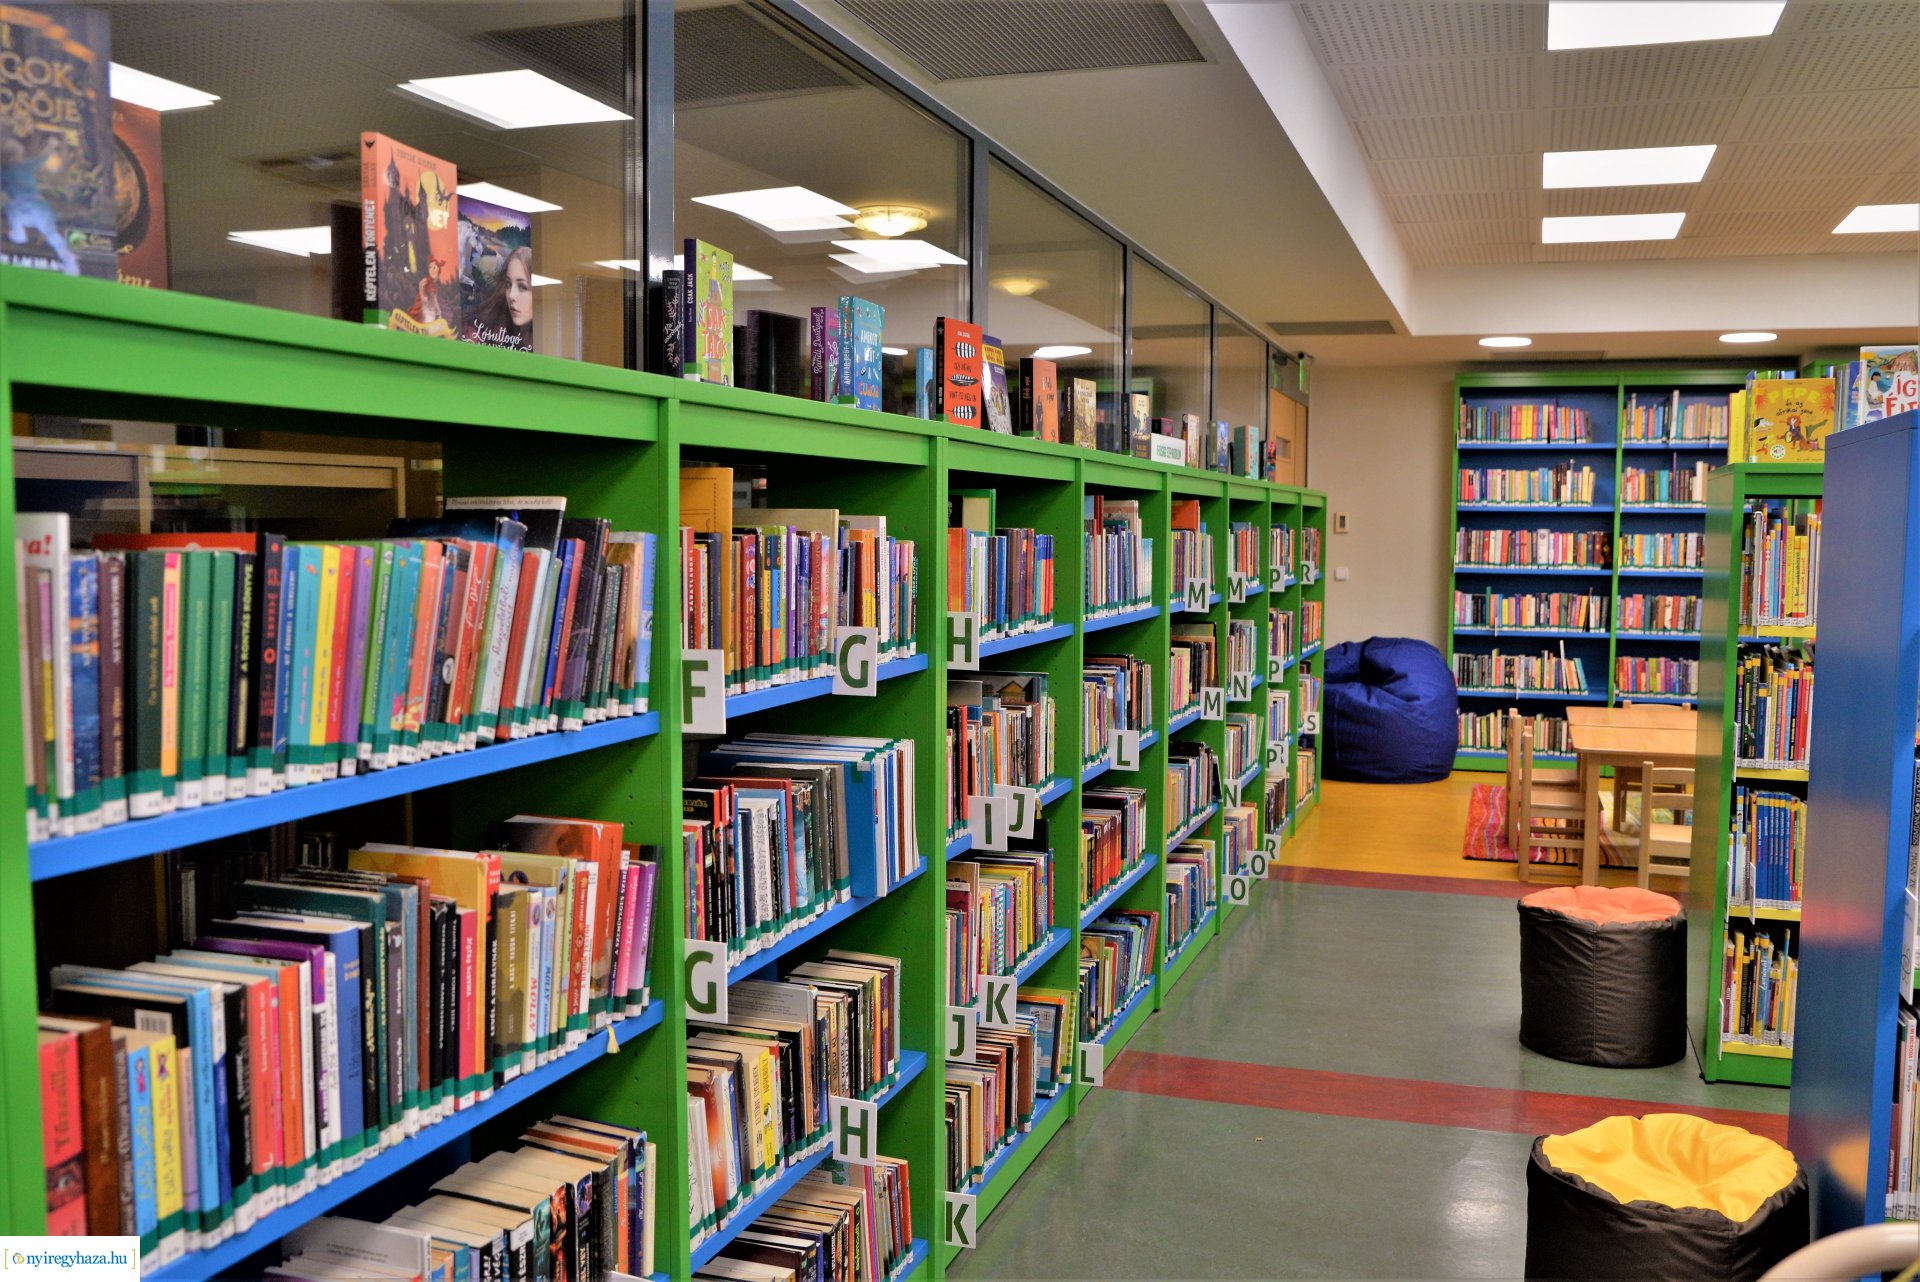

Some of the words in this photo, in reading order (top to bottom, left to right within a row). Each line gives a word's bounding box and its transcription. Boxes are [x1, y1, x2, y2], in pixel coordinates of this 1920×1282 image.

[363, 199, 376, 250] TÖRTÉNET
[364, 251, 377, 302] KÉPTELEN
[700, 301, 727, 330] CSAK
[701, 330, 728, 360] JACK
[1767, 386, 1821, 404] PEPE
[242, 563, 254, 612] KÖNYVE
[1228, 577, 1243, 600] M
[1270, 569, 1281, 588] P
[1301, 565, 1311, 582] R
[1187, 582, 1206, 609] M
[239, 612, 251, 661] RONTÁS
[946, 616, 971, 663] H
[241, 661, 249, 672] A
[839, 634, 869, 688] G
[1268, 660, 1280, 681] P
[682, 659, 709, 724] F
[1233, 675, 1247, 698] N
[1203, 691, 1221, 717] M
[1306, 714, 1316, 731] S
[1117, 734, 1131, 766] L
[1266, 748, 1277, 768] P
[1224, 783, 1238, 808] N
[1009, 792, 1025, 833] J
[1265, 839, 1276, 859] R
[1910, 853, 1918, 876] ANYAG
[1250, 854, 1265, 876] O
[1230, 877, 1246, 900] O
[614, 895, 625, 948] SZEMÜVEGES
[543, 965, 552, 1000] MOLLY
[685, 950, 717, 1014] G
[528, 977, 538, 1033] MOLLY
[985, 981, 1009, 1025] K
[949, 1014, 965, 1057] J
[1080, 1043, 1095, 1083] L
[840, 1105, 868, 1159] H
[945, 1201, 970, 1245] K
